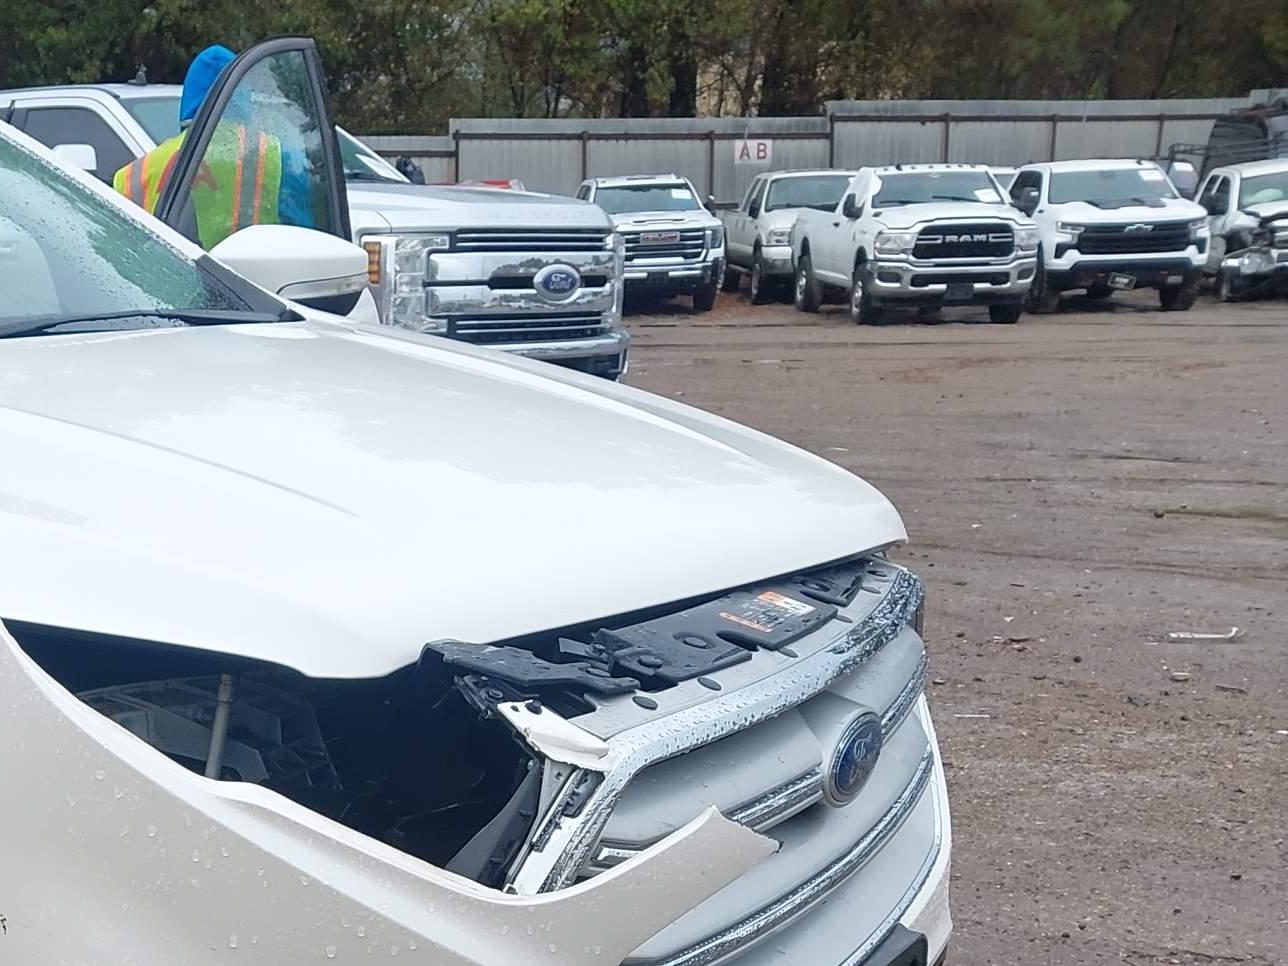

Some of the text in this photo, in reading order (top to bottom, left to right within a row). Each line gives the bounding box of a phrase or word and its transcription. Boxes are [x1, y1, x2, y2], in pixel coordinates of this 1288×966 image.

[739, 141, 768, 160] A B
[944, 233, 988, 243] RAM
